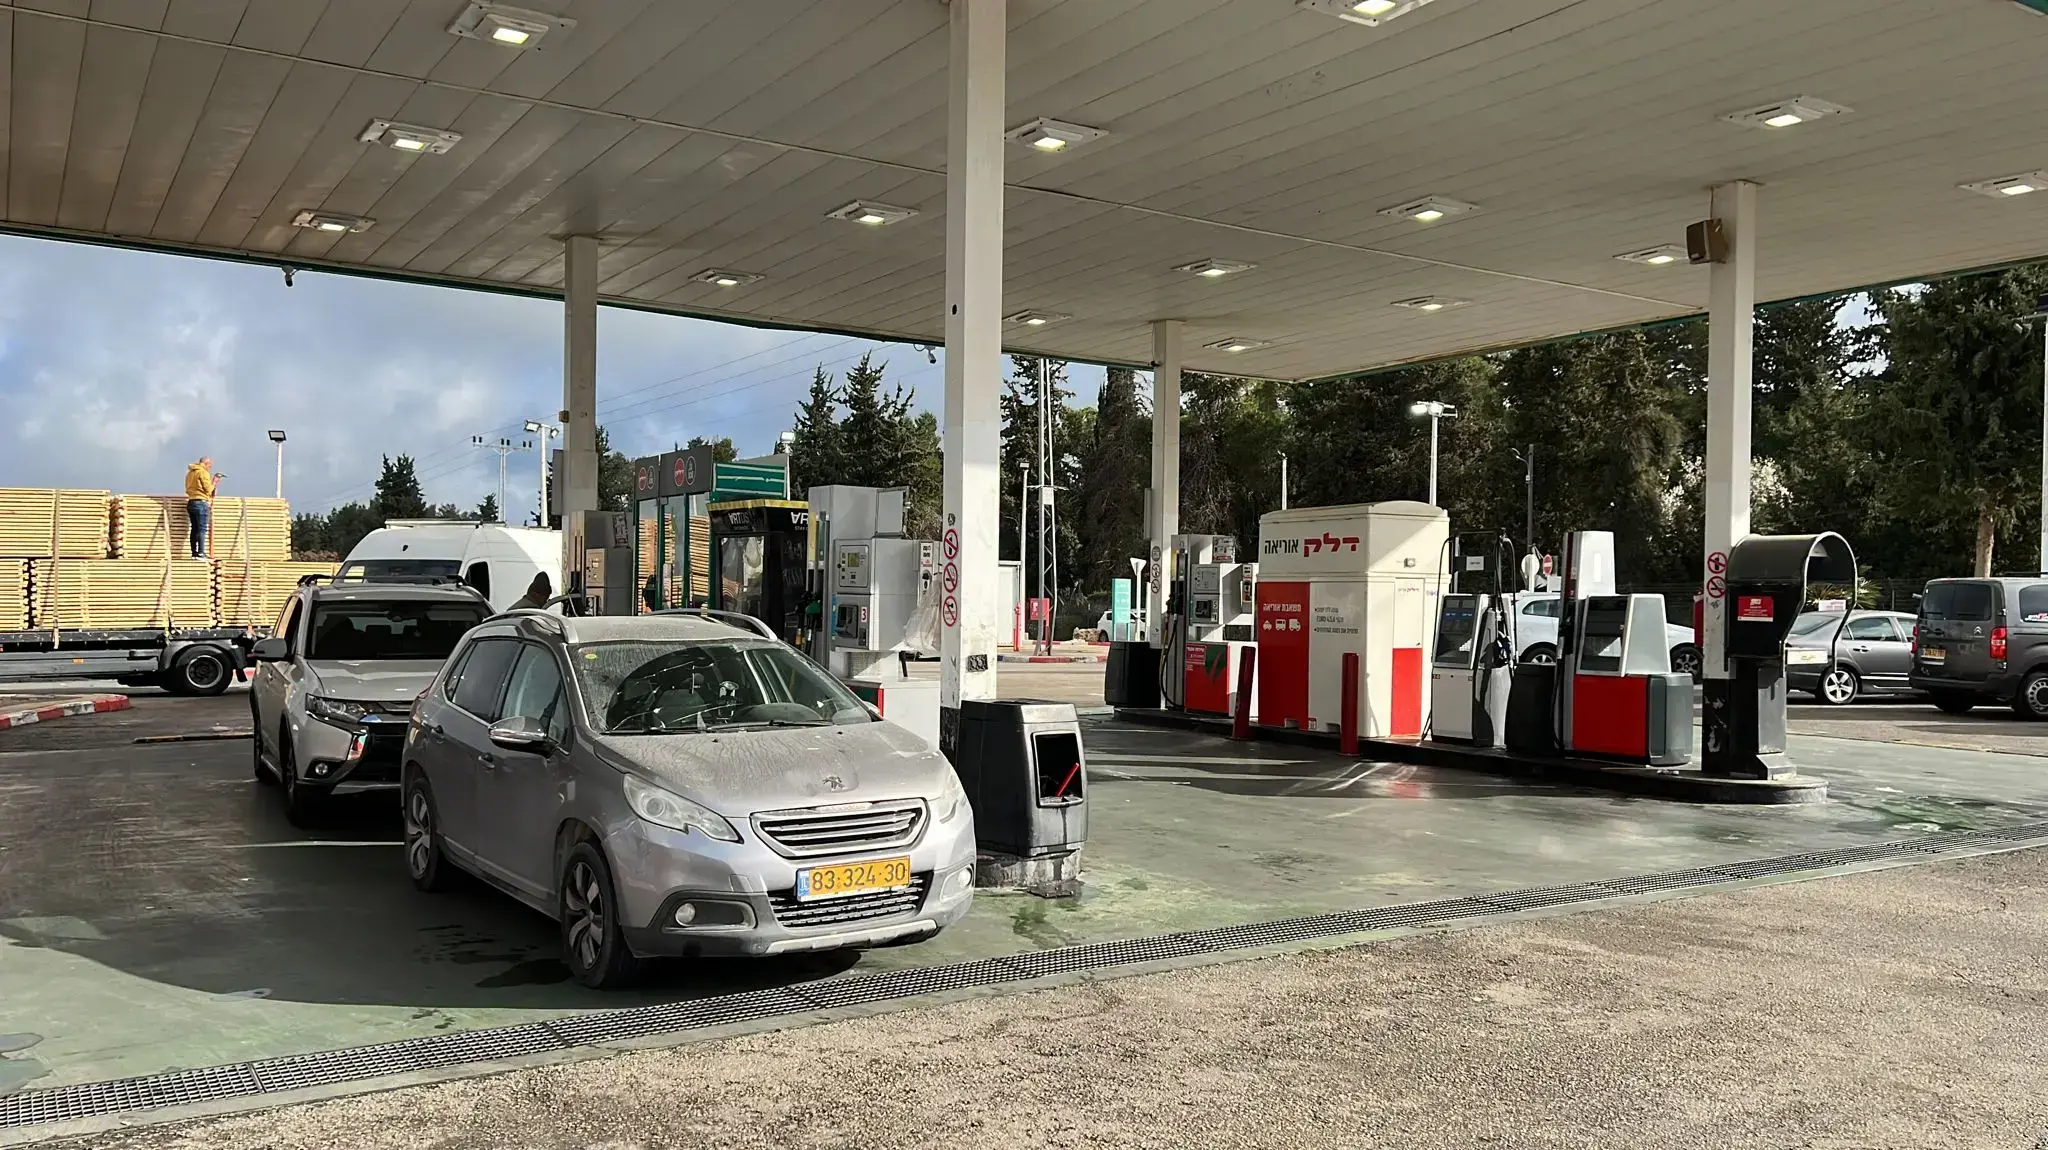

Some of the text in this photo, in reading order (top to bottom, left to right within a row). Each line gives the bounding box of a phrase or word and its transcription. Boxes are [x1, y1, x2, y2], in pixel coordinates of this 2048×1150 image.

[1264, 532, 1360, 557] דלק אוריאה
[862, 608, 867, 621] 3
